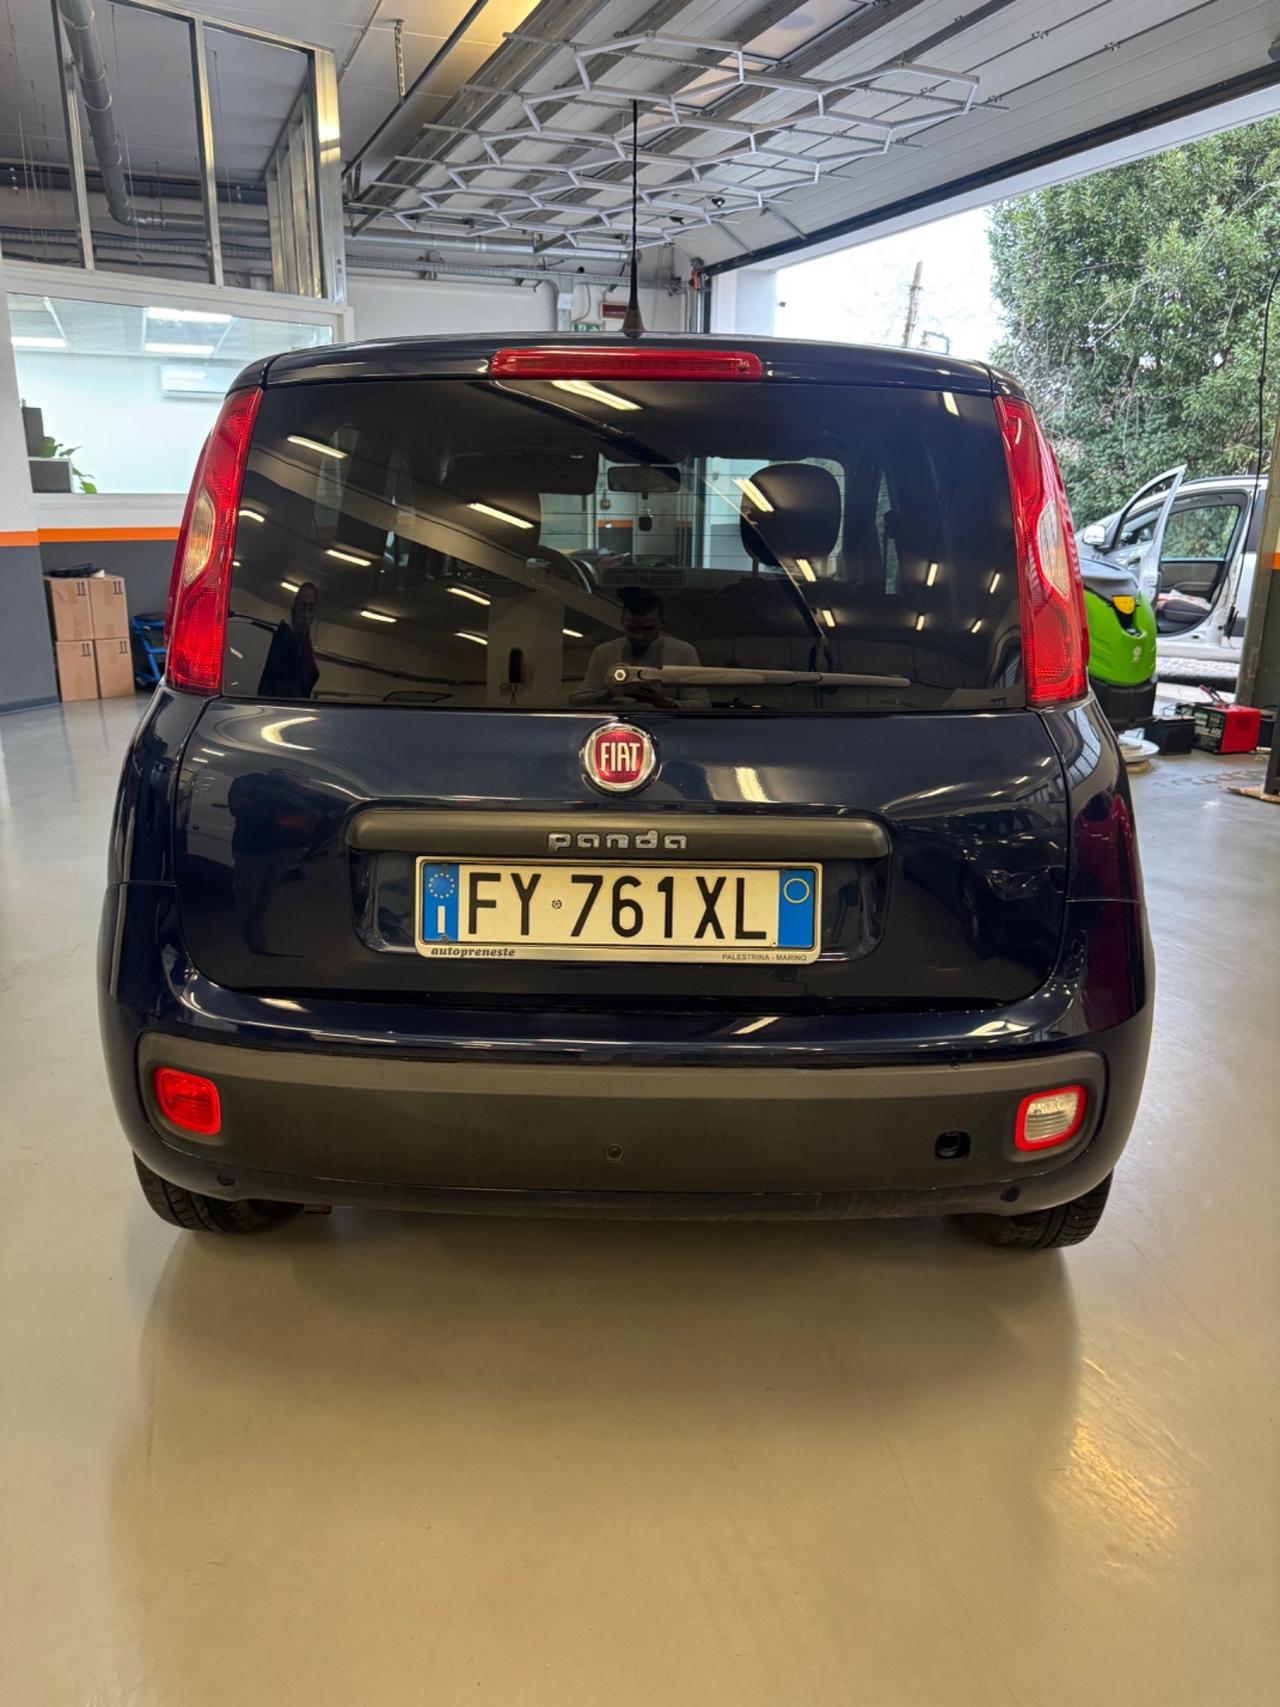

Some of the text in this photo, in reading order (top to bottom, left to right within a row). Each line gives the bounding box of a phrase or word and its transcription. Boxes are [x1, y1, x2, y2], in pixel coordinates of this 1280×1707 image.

[600, 742, 640, 772] FIAT
[548, 829, 688, 851] panda
[468, 872, 542, 936] FY
[431, 946, 515, 958] autopreneste
[721, 953, 770, 961] PALESTRINA
[776, 954, 807, 962] MARINO
